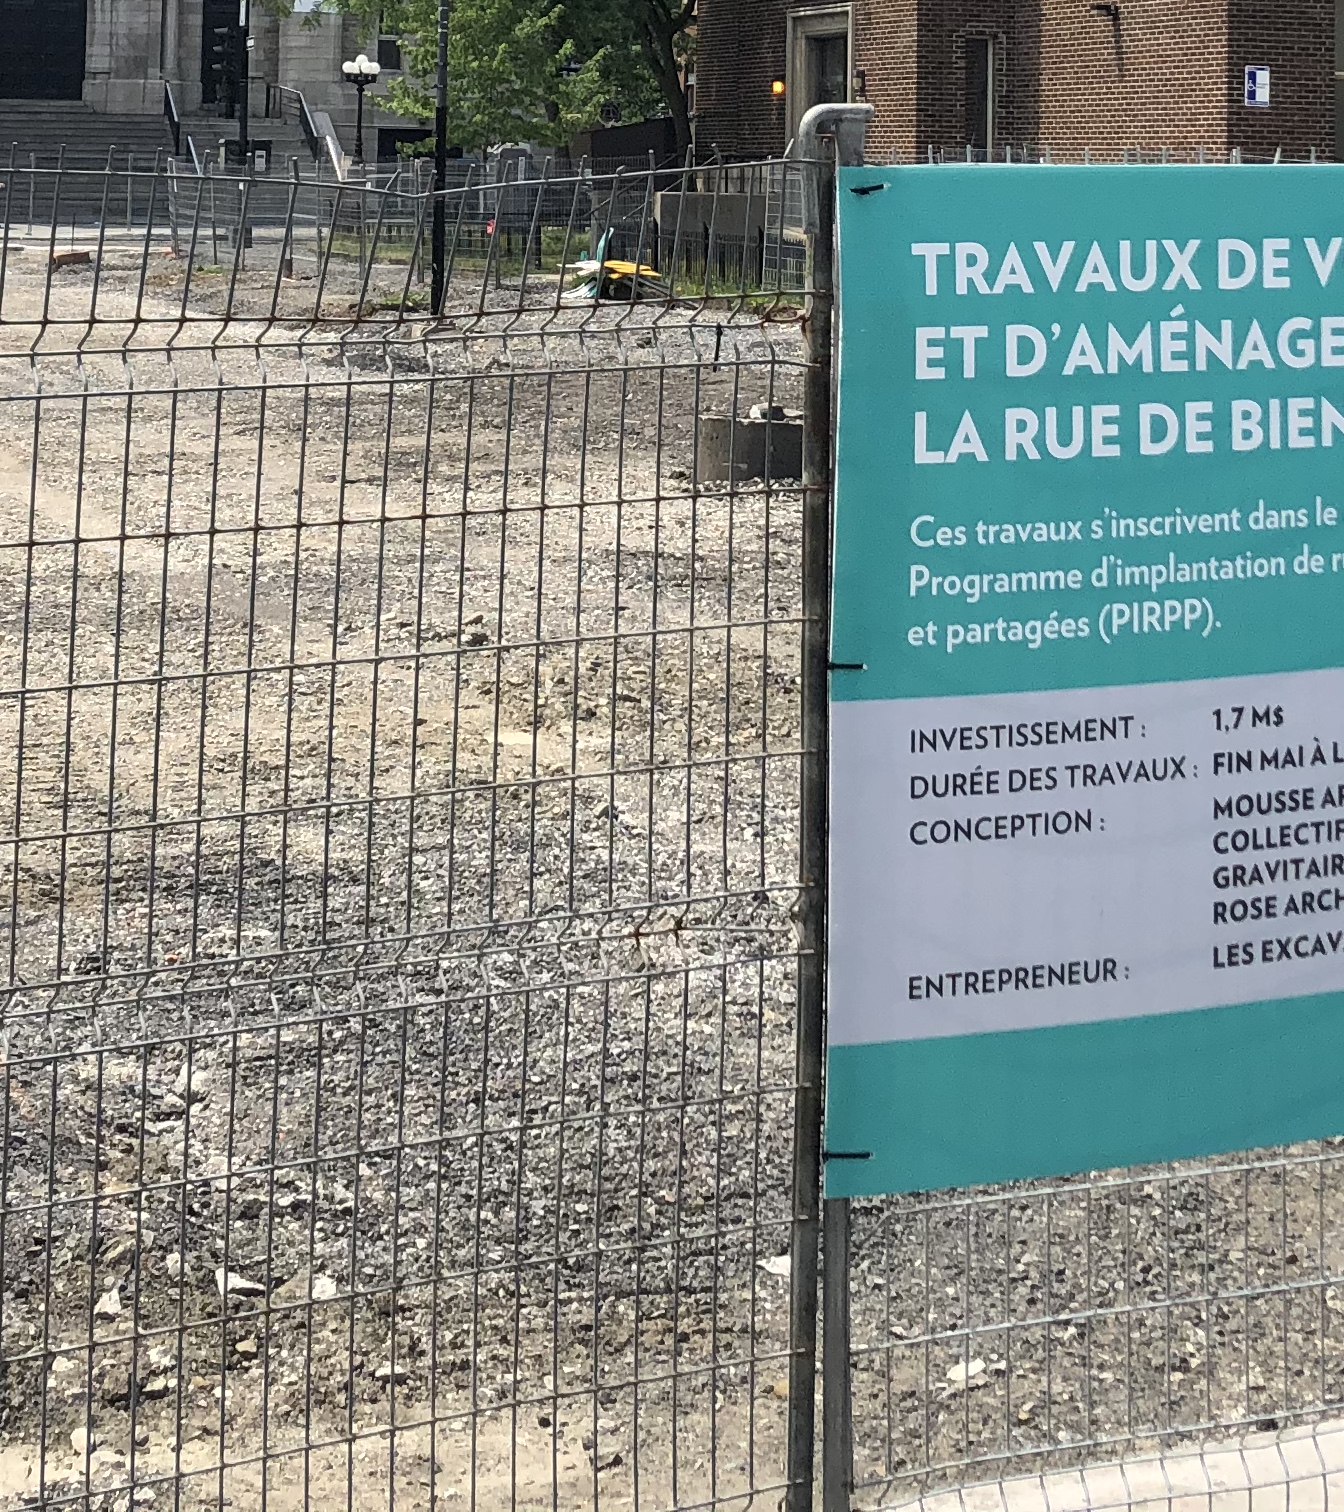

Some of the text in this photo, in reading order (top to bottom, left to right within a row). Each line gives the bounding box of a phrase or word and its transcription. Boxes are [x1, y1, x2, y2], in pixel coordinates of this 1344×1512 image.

[910, 239, 1202, 296] TRAVAUX
[1217, 237, 1291, 290] DE
[915, 325, 989, 380] ET
[914, 409, 990, 465] LA
[1004, 404, 1121, 461] RUE
[1138, 400, 1214, 456] DE
[910, 514, 967, 548] Ces
[974, 519, 1083, 545] travaux
[1090, 506, 1242, 540] s'inscrivent
[1248, 499, 1309, 531] dans
[1315, 495, 1338, 526] le
[909, 564, 1083, 603] Programme
[1090, 551, 1286, 593] d'implantation
[1293, 543, 1325, 575] de
[907, 597, 1222, 653] et partagées (PIRPP).
[910, 715, 1135, 754] INVESTISSEMENT
[1212, 704, 1284, 732] 1,7 M$
[910, 764, 1000, 800] DURÉE
[1008, 766, 1058, 793] DES
[1064, 755, 1186, 789] TRAVAUX
[1213, 750, 1253, 777] FIN
[1260, 745, 1304, 771] MAI
[1310, 736, 1327, 767] À
[1213, 787, 1315, 820] MOUSSE
[909, 808, 1092, 846] CONCEPTION
[1213, 895, 1278, 925] ROSE
[1213, 942, 1255, 969] LES
[908, 957, 1118, 1000] ENTREPRENEUR
